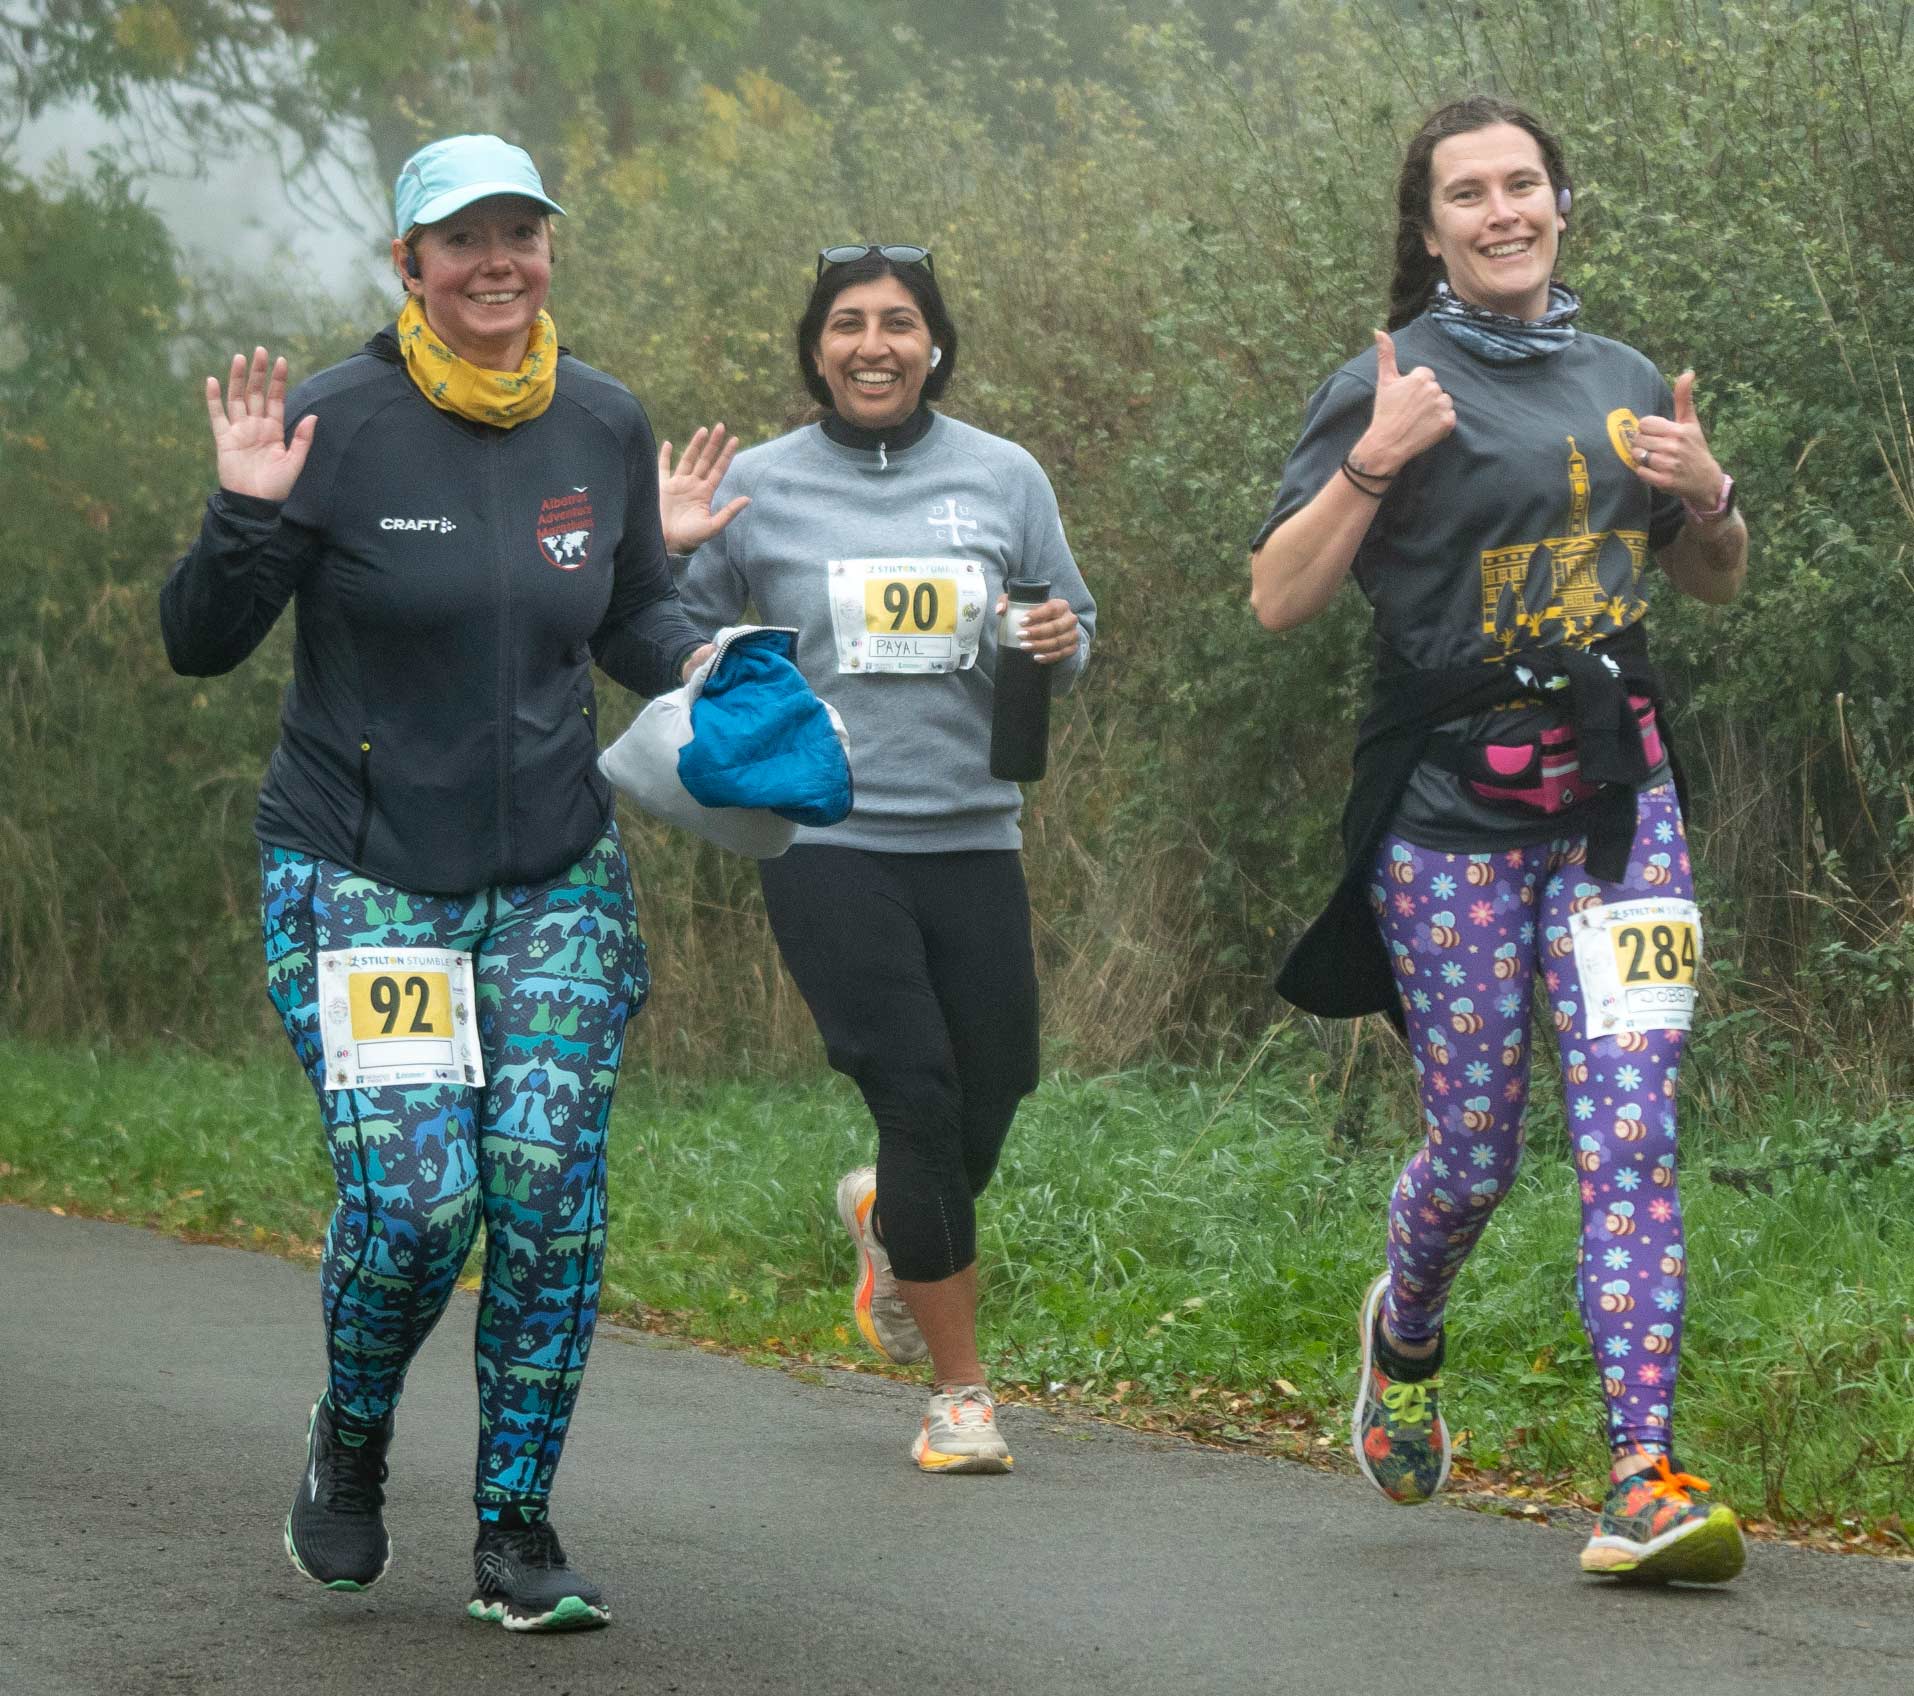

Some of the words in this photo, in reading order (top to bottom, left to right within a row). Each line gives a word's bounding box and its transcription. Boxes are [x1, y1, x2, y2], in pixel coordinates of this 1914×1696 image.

[380, 518, 439, 531] CRAFT
[884, 582, 938, 631] 90
[876, 639, 925, 657] PAYAL
[407, 956, 450, 967] STUMBLE
[1618, 925, 1695, 984] 284
[370, 976, 434, 1034] 92
